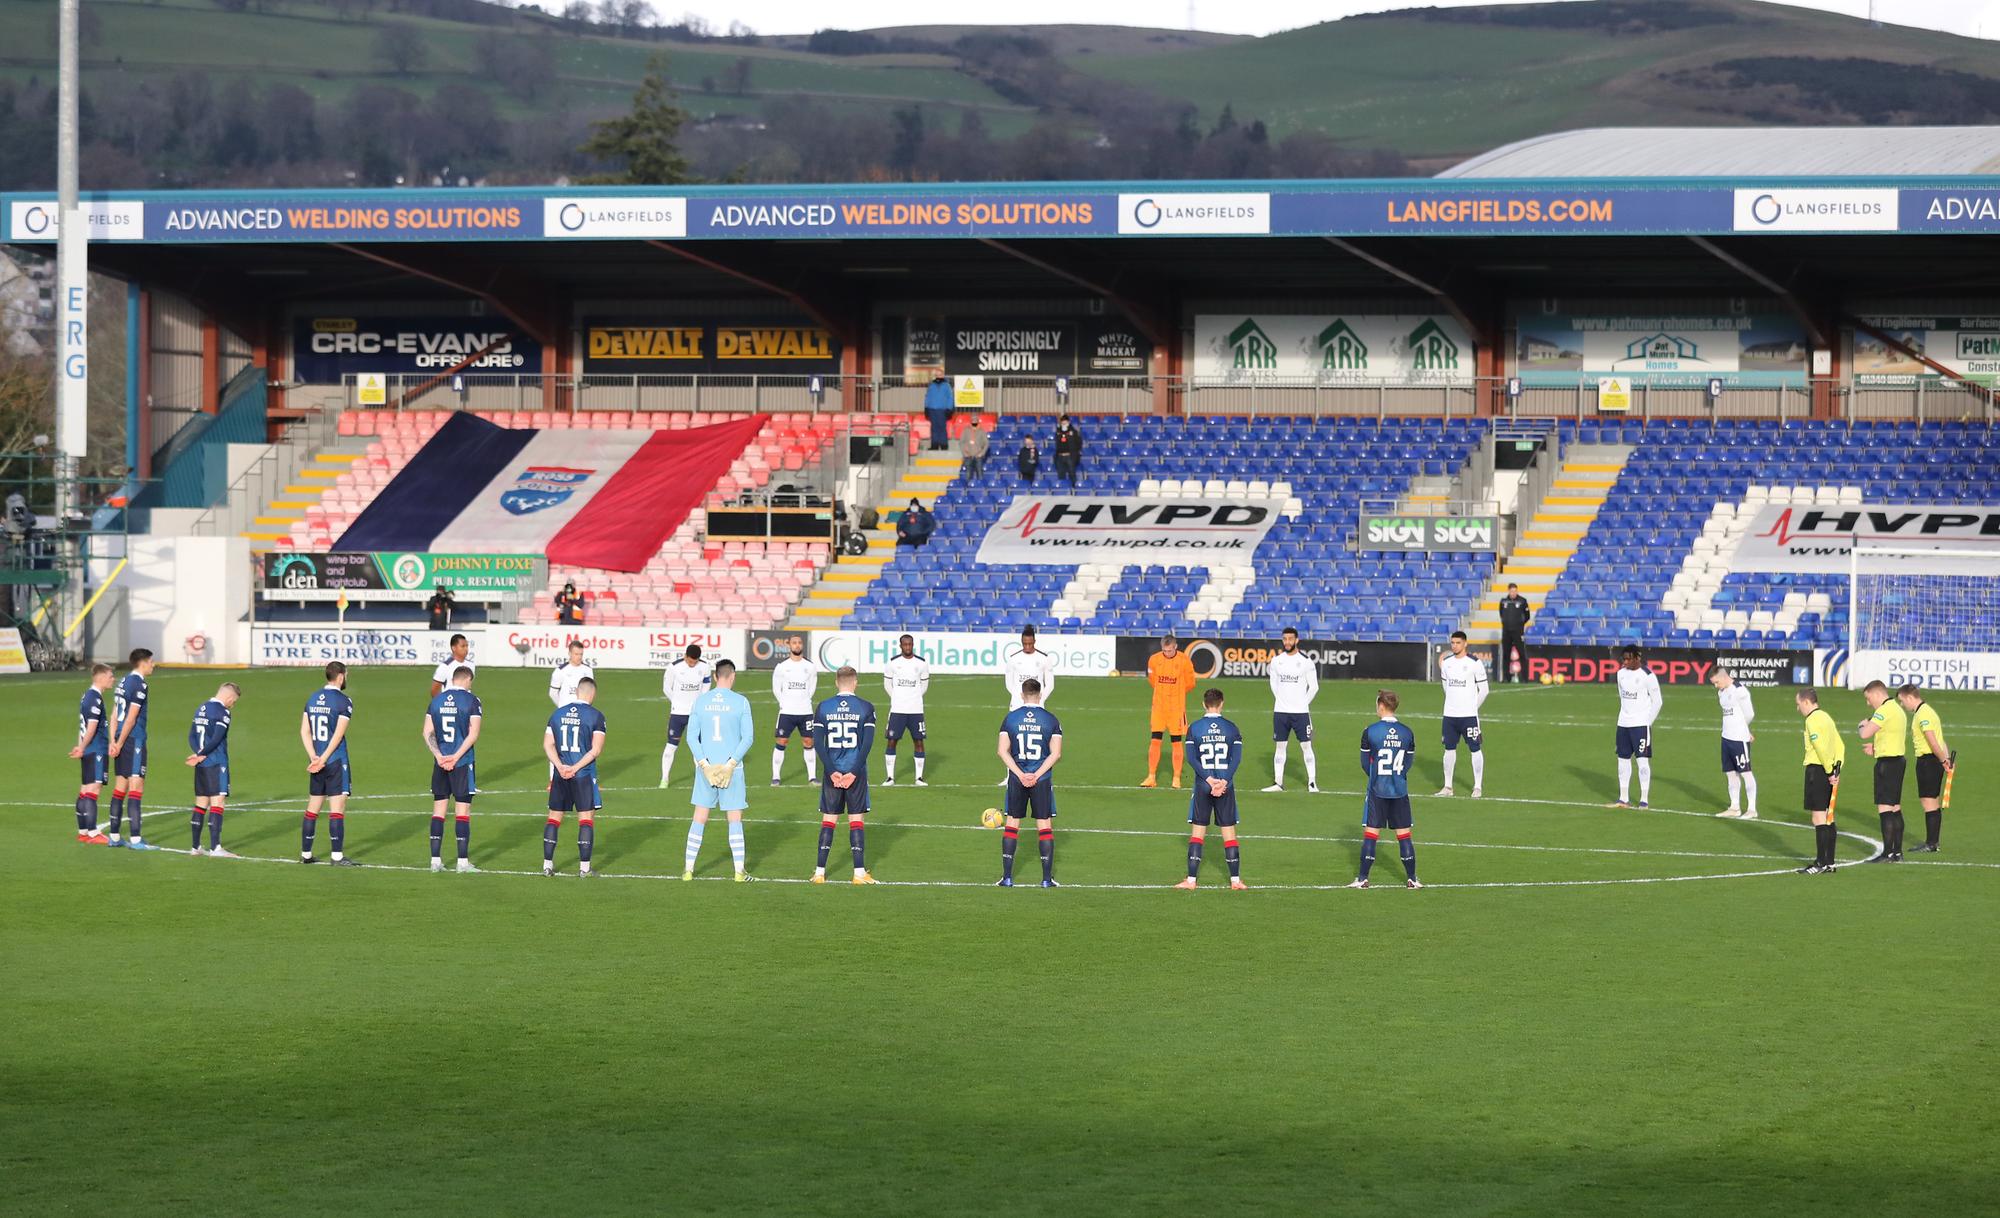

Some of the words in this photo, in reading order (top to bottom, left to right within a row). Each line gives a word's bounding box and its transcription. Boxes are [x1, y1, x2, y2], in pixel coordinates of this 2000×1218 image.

[589, 210, 673, 222] LANGFIELDS
[710, 206, 836, 227] ADVANCED
[842, 205, 951, 225] WELDING
[956, 203, 1093, 224] SOLUTIONS
[1166, 206, 1256, 219] LANGFIELDS
[1387, 200, 1614, 222] LANGFIELDS.COM
[1785, 202, 1882, 215] LANGFIELDS
[1927, 198, 2000, 220] ADVA
[52, 214, 130, 226] LFIELDS
[165, 209, 283, 230] ADVANCED
[288, 208, 391, 230] WELDING
[395, 207, 521, 229] SOLUTIONS
[1882, 318, 1936, 330] Engineering
[312, 333, 512, 354] CRC-EVANS
[956, 331, 1062, 351] SURPRISINGLY
[1098, 333, 1134, 347] WHYTE
[1097, 347, 1137, 357] MACKAY
[1649, 351, 1675, 359] Munro
[978, 351, 1039, 371] SMOOTH
[1645, 361, 1678, 371] Homes
[453, 376, 463, 391] A
[811, 376, 821, 392] A
[1710, 379, 1721, 396] C
[1043, 503, 1268, 526] HVPD
[1367, 518, 1425, 544] SIGN
[1434, 519, 1492, 545] SIGN
[1029, 537, 1246, 550] www.hvpd.co.uk
[326, 556, 348, 564] wine
[349, 555, 367, 564] bar
[432, 557, 494, 573] JOHNNY
[326, 566, 345, 576] and
[284, 569, 318, 589] den
[326, 578, 368, 588] nightclub
[432, 576, 454, 587] PUB
[456, 577, 465, 587] &
[264, 632, 413, 647] INVERGORDON
[508, 632, 560, 649] Corrie
[650, 633, 721, 648] ISUZU
[263, 647, 322, 659] TYRE
[533, 652, 598, 666] Inverss
[650, 652, 671, 660] THE
[868, 638, 998, 667] Hihland
[1003, 641, 1110, 670] Cpiers
[1224, 648, 1281, 664] GLOBA
[1301, 649, 1357, 666] OJECT
[1223, 662, 1270, 677] SERVI
[1716, 657, 1790, 668] RESTAURANT
[1888, 658, 1970, 673] SCOTTISH
[1528, 656, 1712, 685] REDPPPY
[1729, 670, 1739, 679] &
[1741, 669, 1777, 679] EVENT
[826, 714, 860, 722] DONALDSON
[310, 715, 329, 742] 16
[442, 716, 456, 743] 5
[712, 715, 722, 742] 1
[827, 721, 858, 749] 25
[1018, 724, 1041, 733] WATSON
[1467, 726, 1479, 738] 26
[560, 725, 581, 752] 11
[1201, 735, 1226, 743] TILLSON
[1383, 739, 1402, 748] PATON
[1016, 733, 1043, 760] 15
[1199, 742, 1229, 770] 22
[1377, 749, 1406, 776] 24
